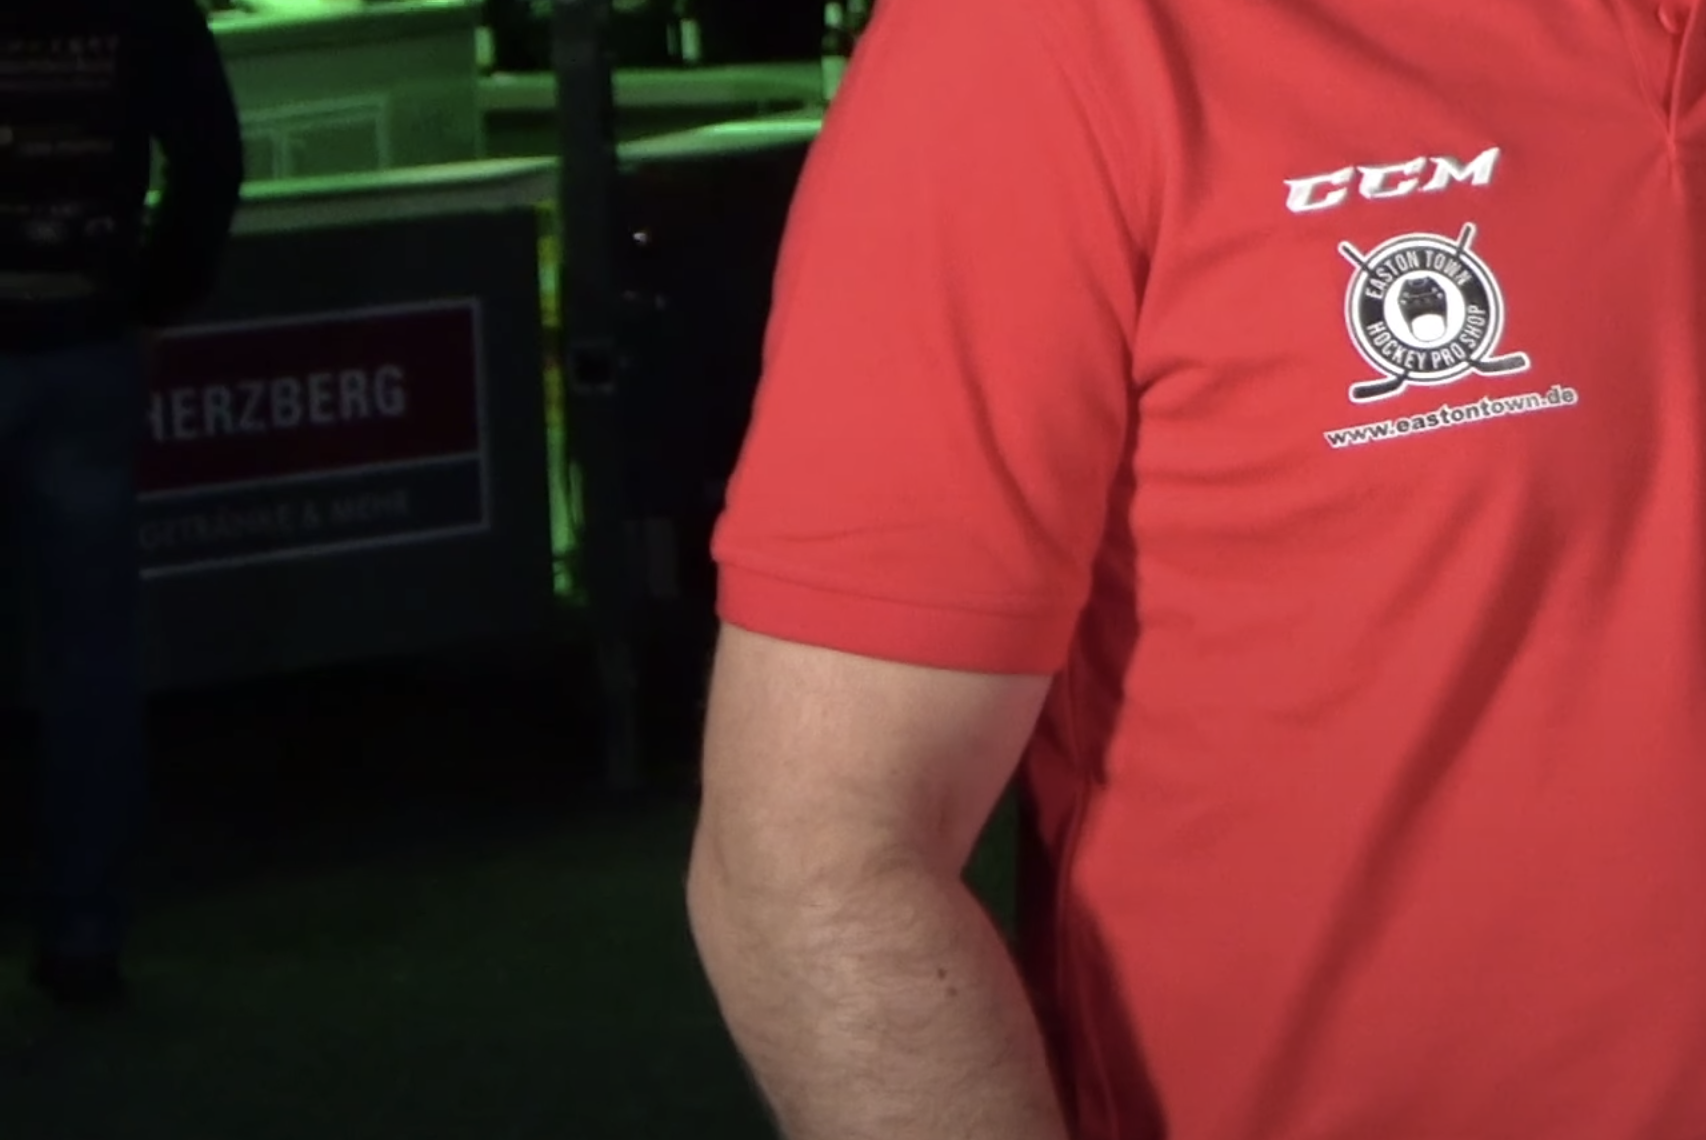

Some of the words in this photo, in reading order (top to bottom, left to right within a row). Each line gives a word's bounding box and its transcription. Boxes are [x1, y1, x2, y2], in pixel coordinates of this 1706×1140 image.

[1284, 147, 1500, 213] CCM
[1366, 251, 1420, 299] EASTON
[1425, 250, 1472, 286] TOWN
[1366, 321, 1427, 370] HOCKEY
[1431, 342, 1466, 370] PRO
[1460, 305, 1487, 348] SHOP
[1326, 385, 1576, 448] www.eastontown.de
